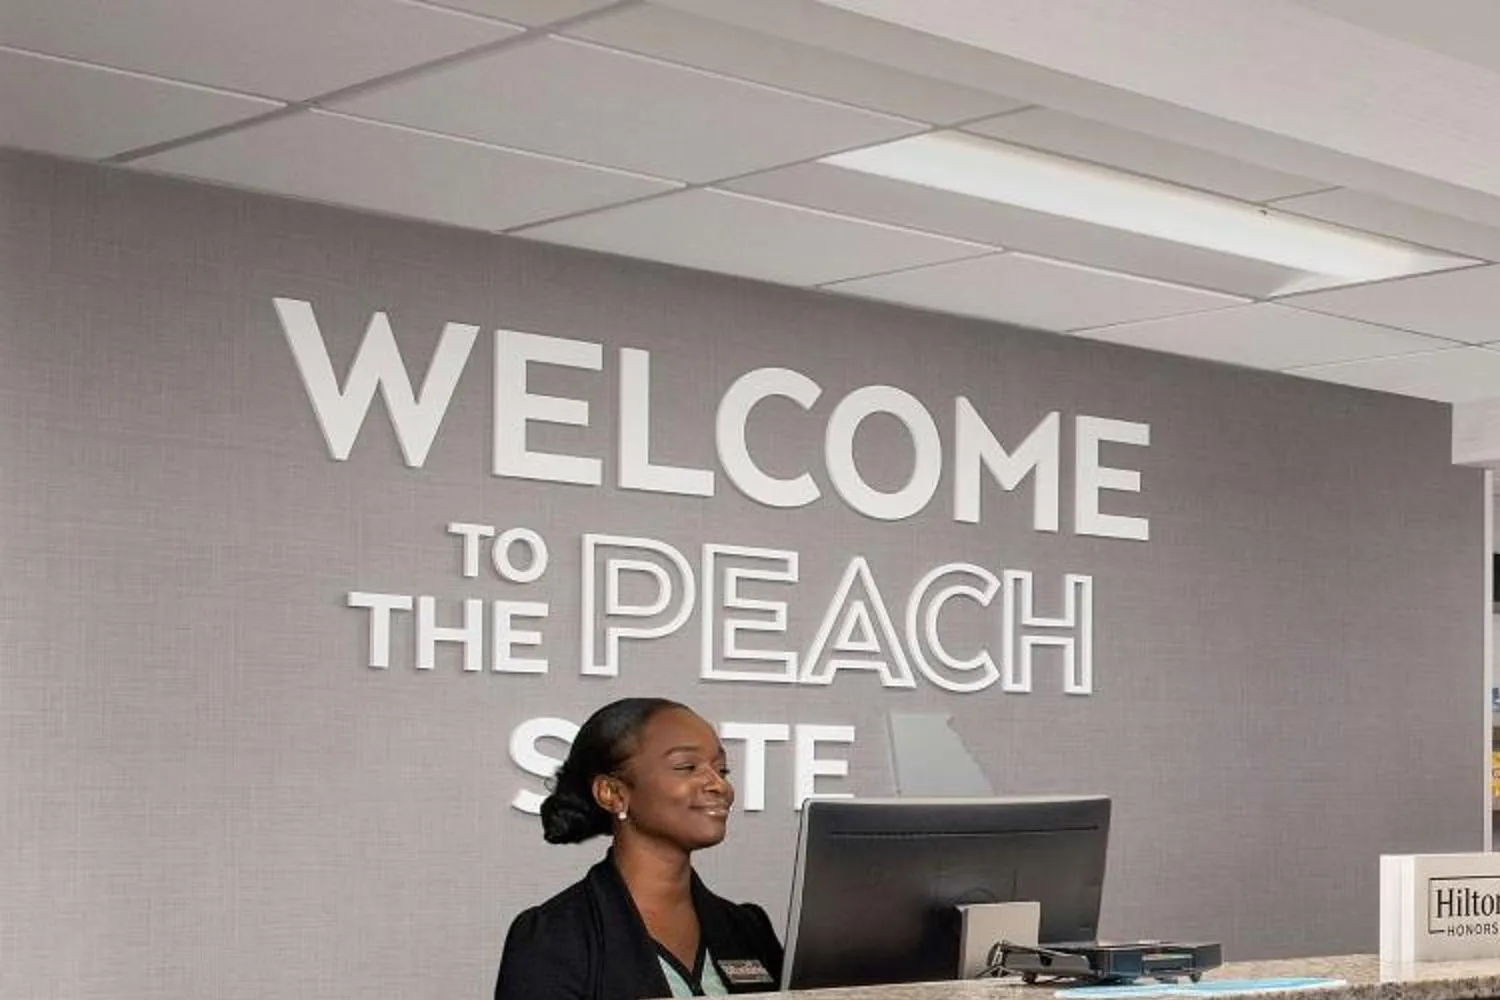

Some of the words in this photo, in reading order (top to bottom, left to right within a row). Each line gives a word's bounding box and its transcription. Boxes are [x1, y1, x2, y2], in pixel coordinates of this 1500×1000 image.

[273, 297, 1151, 541] WELCOME
[447, 521, 549, 583] TO
[348, 591, 549, 674] THE
[580, 533, 1093, 695] PEACH
[509, 717, 855, 815] STE
[1447, 922, 1499, 936] HONORS
